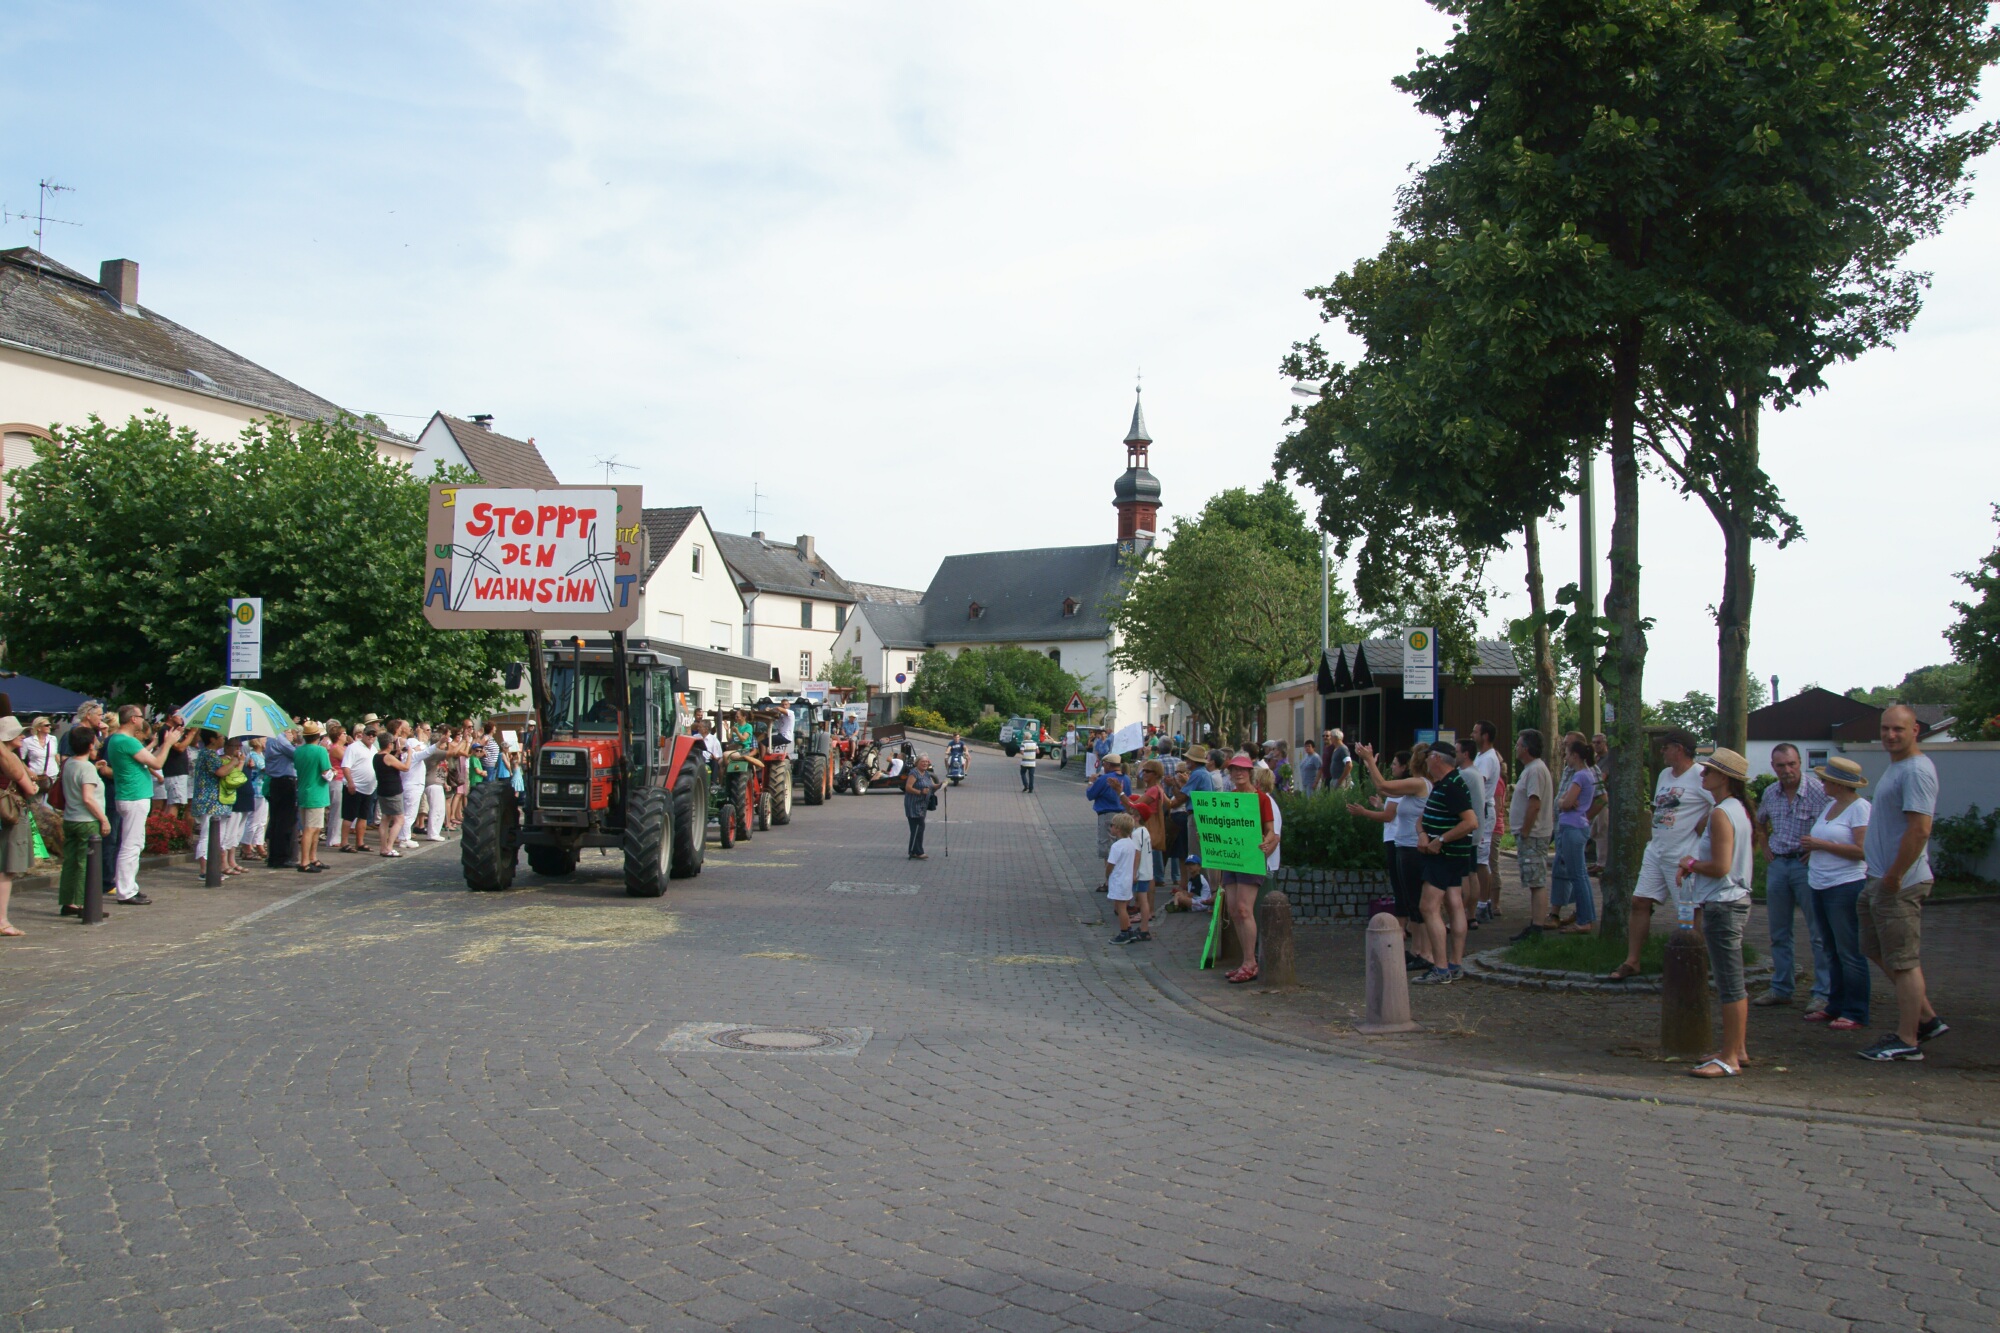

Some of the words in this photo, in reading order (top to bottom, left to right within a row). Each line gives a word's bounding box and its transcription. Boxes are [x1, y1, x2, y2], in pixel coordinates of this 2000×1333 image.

[466, 502, 597, 539] STOPPT
[501, 543, 556, 567] DEN
[1197, 799, 1208, 807] Alle
[1212, 798, 1217, 807] 5
[1220, 800, 1230, 808] km
[1234, 798, 1239, 808] 5
[1199, 814, 1255, 828] Windgiganten
[1202, 832, 1221, 844] NEIN
[1205, 848, 1222, 857] Wehrt
